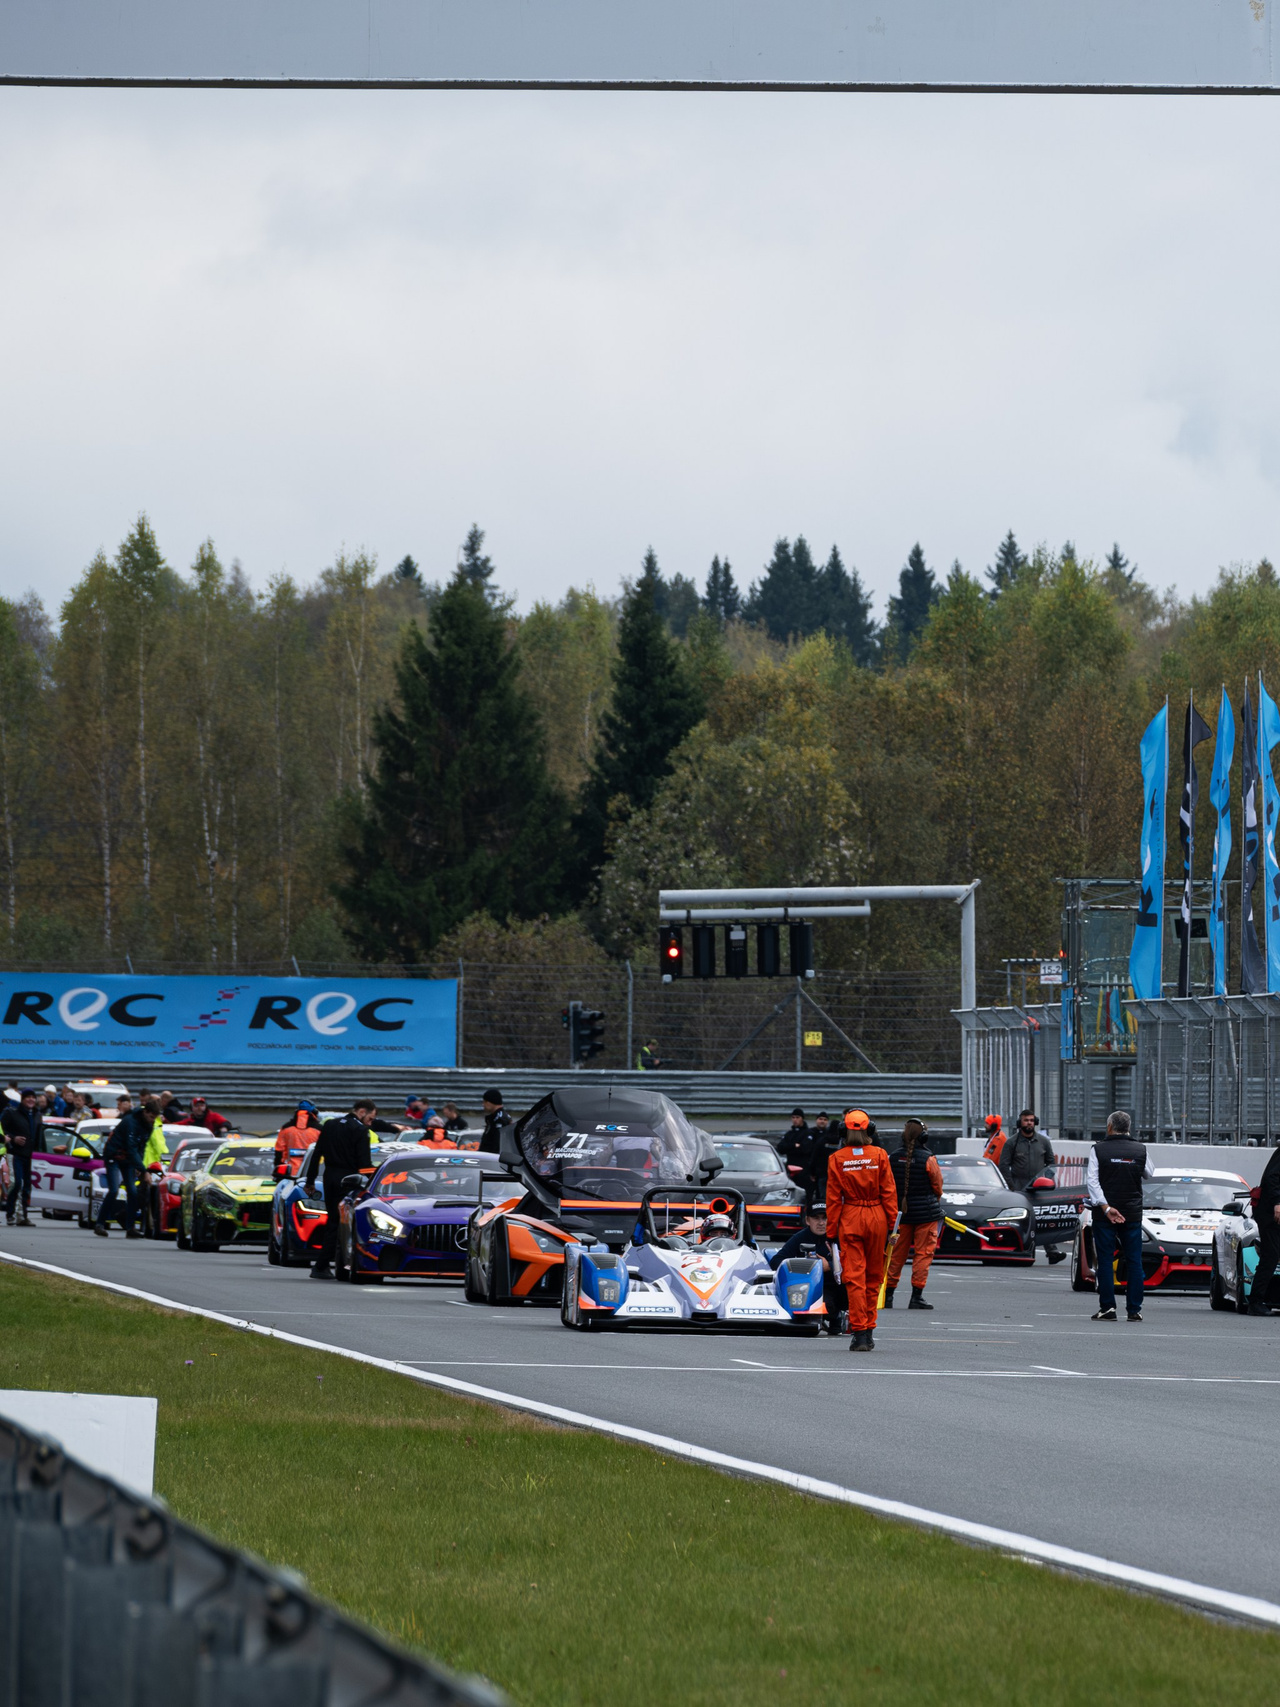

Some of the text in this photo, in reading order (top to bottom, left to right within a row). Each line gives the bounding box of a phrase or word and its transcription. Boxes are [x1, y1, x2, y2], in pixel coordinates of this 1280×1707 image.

[563, 1132, 588, 1148] 71
[180, 1148, 200, 1159] 27
[215, 1157, 236, 1167] 4
[380, 1171, 409, 1185] 66
[627, 1306, 673, 1314] AIMOL
[732, 1307, 777, 1315] AIMOL
